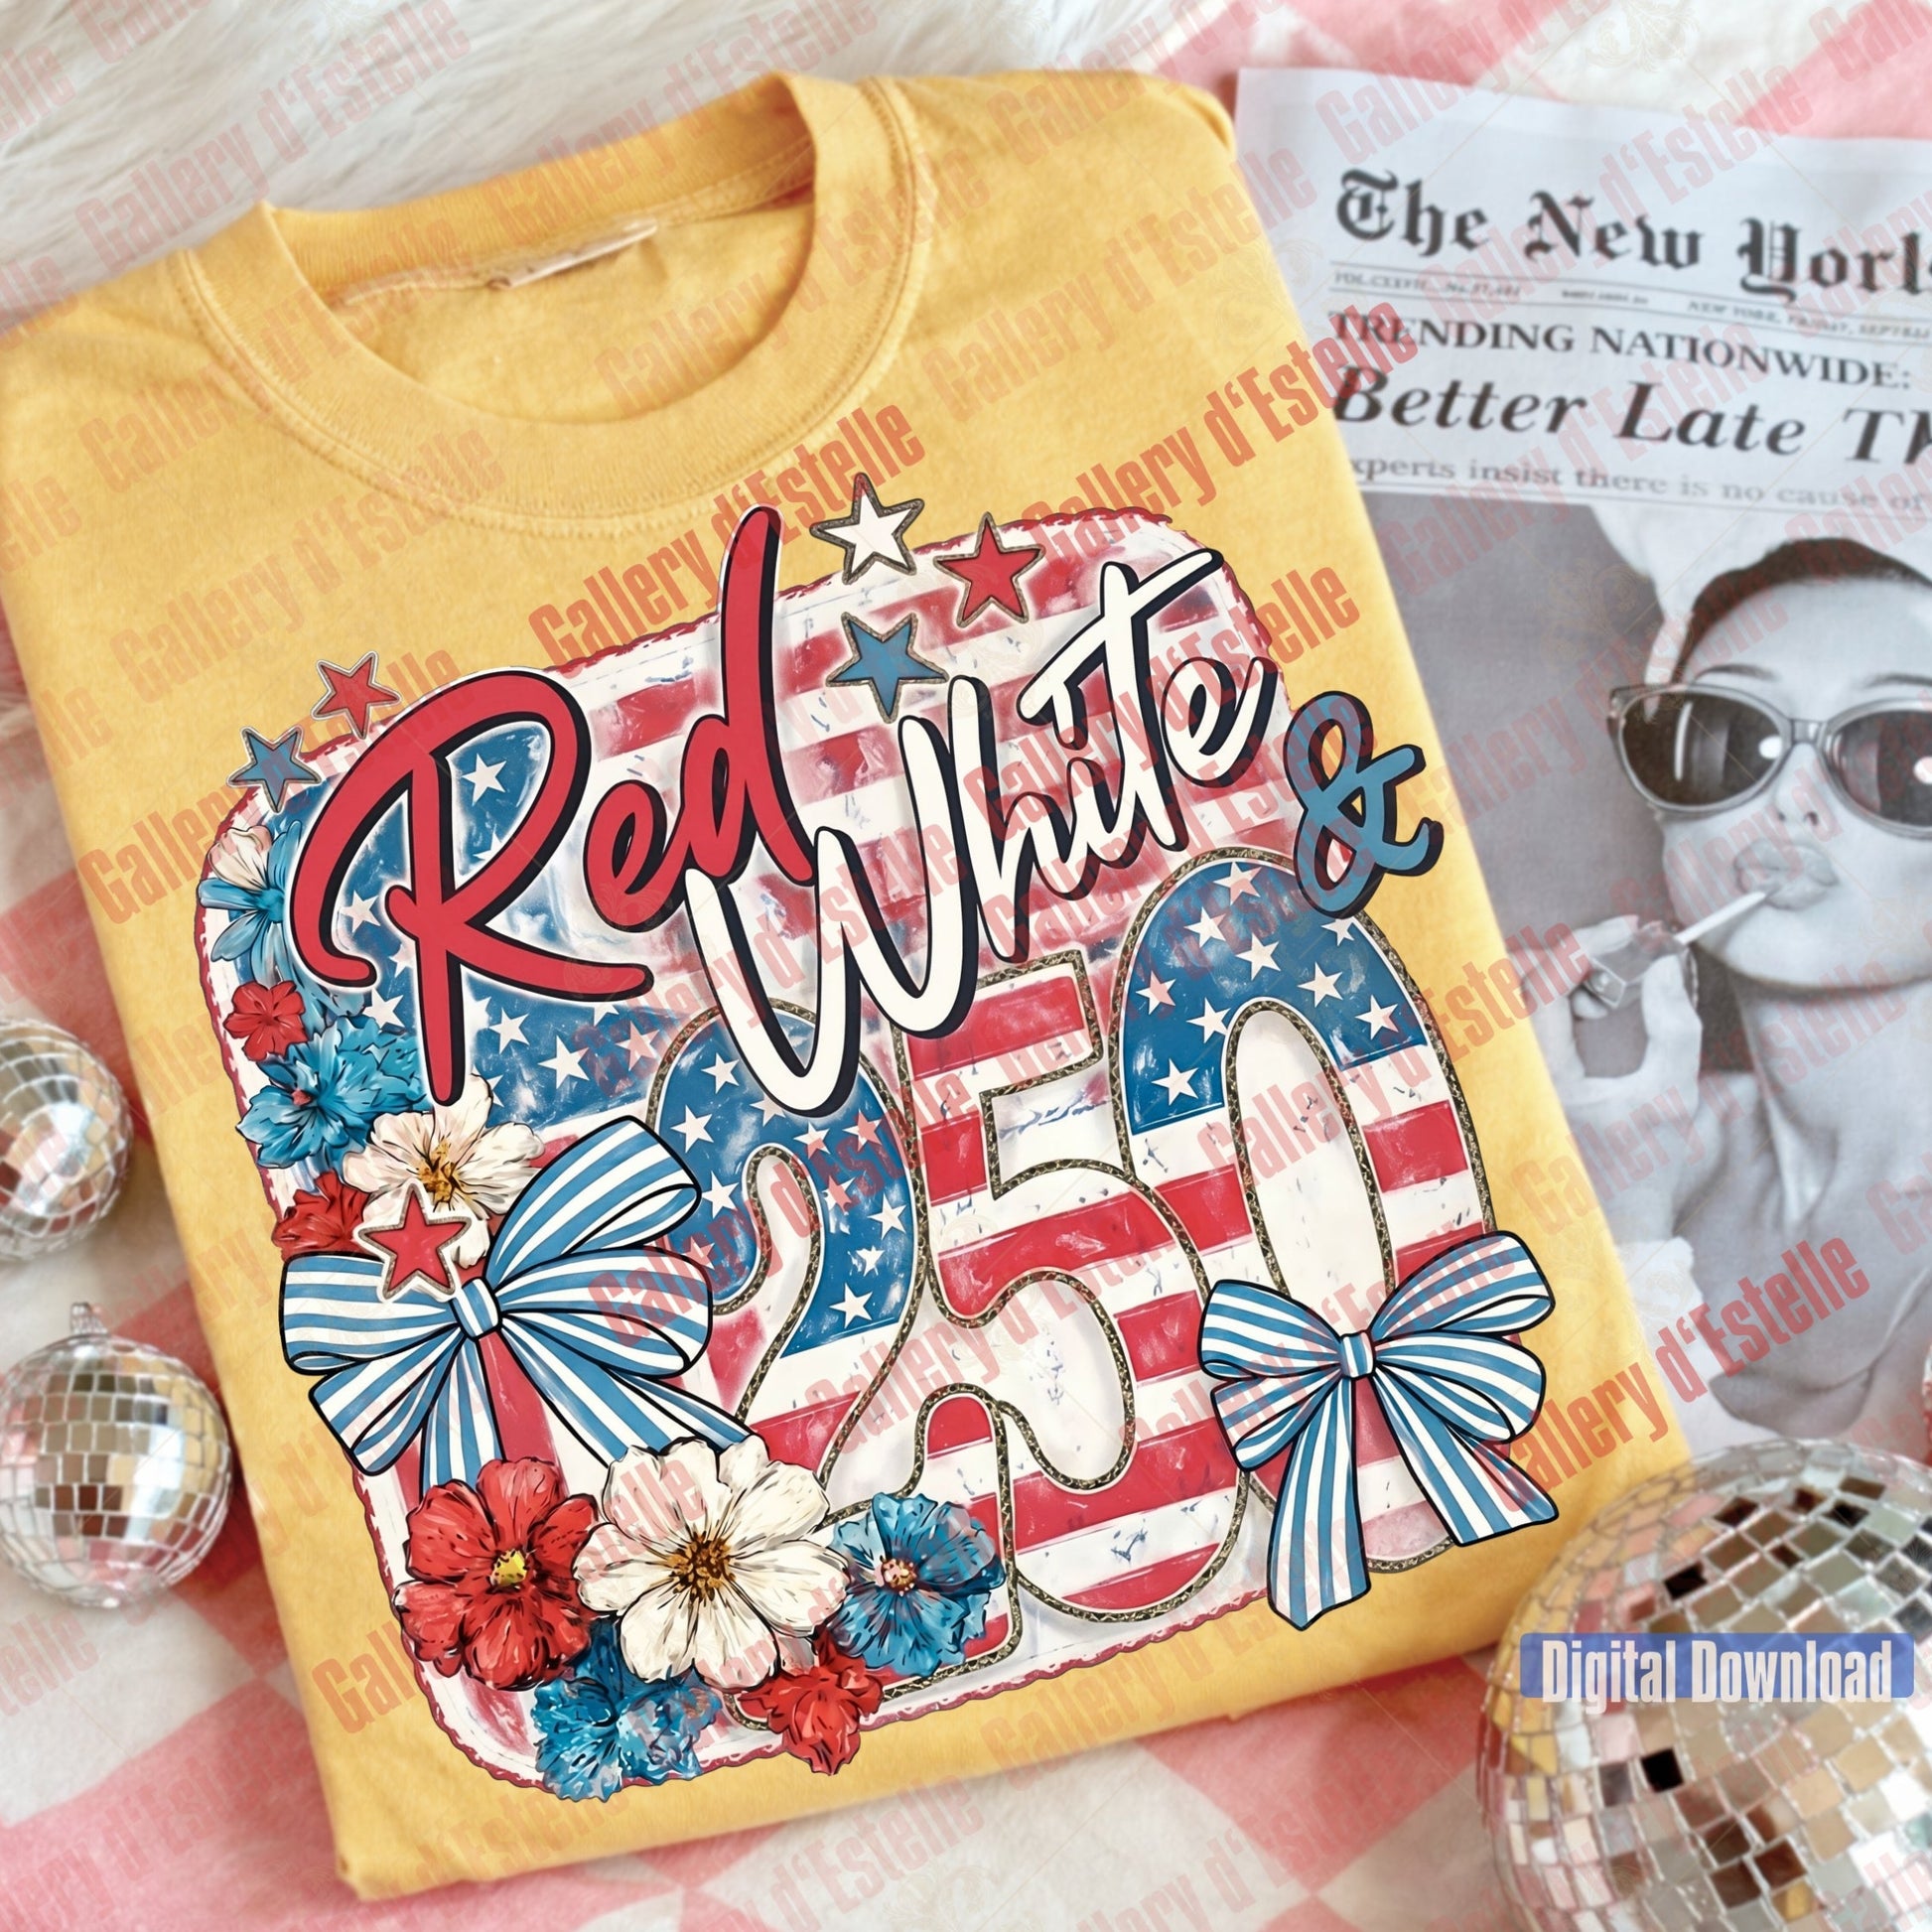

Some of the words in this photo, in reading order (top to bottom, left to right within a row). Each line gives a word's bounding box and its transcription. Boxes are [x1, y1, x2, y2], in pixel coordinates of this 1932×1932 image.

[1336, 169, 1489, 258] The
[1523, 189, 1706, 271] New
[1328, 309, 1575, 352] TRENDING
[1590, 318, 1911, 390] NATIONWIDE:
[1331, 364, 1588, 435] Better
[1610, 379, 1807, 456] Late
[1469, 459, 1565, 486] insist
[1576, 467, 1668, 494] there
[1680, 474, 1709, 497] is
[1722, 483, 1767, 503] no
[288, 504, 818, 1106] Red
[684, 547, 1277, 1113] White
[1282, 689, 1445, 919] &
[647, 846, 1496, 1729] 250
